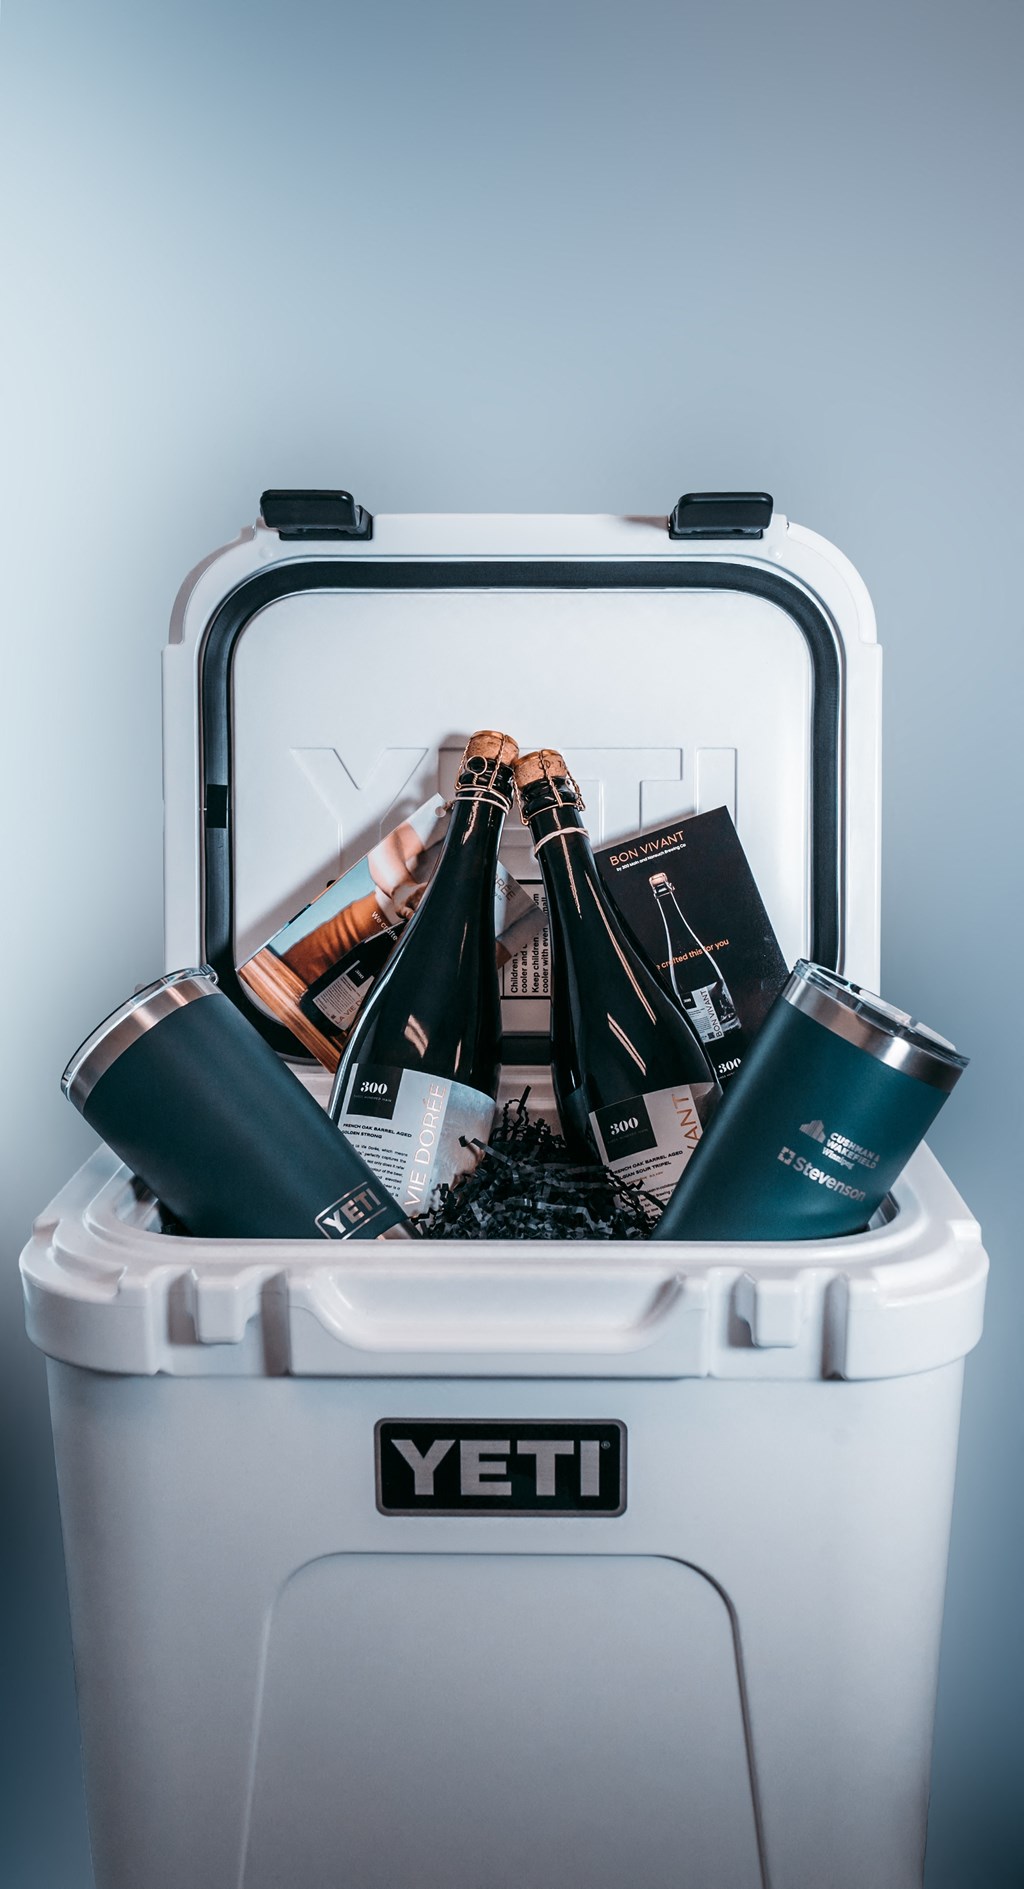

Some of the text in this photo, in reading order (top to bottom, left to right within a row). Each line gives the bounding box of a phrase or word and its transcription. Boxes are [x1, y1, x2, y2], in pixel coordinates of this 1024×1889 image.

[610, 830, 684, 866] BON VIVANT
[494, 874, 516, 901] RÉE
[372, 911, 398, 941] We crafte
[689, 948, 703, 958] this
[715, 939, 730, 950] you
[532, 972, 540, 993] Keep
[700, 990, 716, 1020] VIVANT
[711, 1019, 722, 1038] BON
[718, 1058, 741, 1074] 300
[360, 1081, 388, 1094] 300
[374, 1127, 395, 1135] BARREL
[610, 1117, 638, 1136] 300
[672, 1093, 700, 1150] ANT
[361, 1131, 382, 1139] STRONG
[404, 1083, 446, 1206] VIE DORÉE
[830, 1132, 874, 1159] CUSHMAN
[645, 1155, 667, 1164] BARREL
[652, 1161, 671, 1169] TRIPEL
[822, 1147, 855, 1170] Winnipeg
[826, 1139, 877, 1169] WAKEFIELD
[793, 1157, 866, 1202] Stevenson
[322, 1188, 381, 1234] YETI
[390, 1439, 600, 1496] YETI
